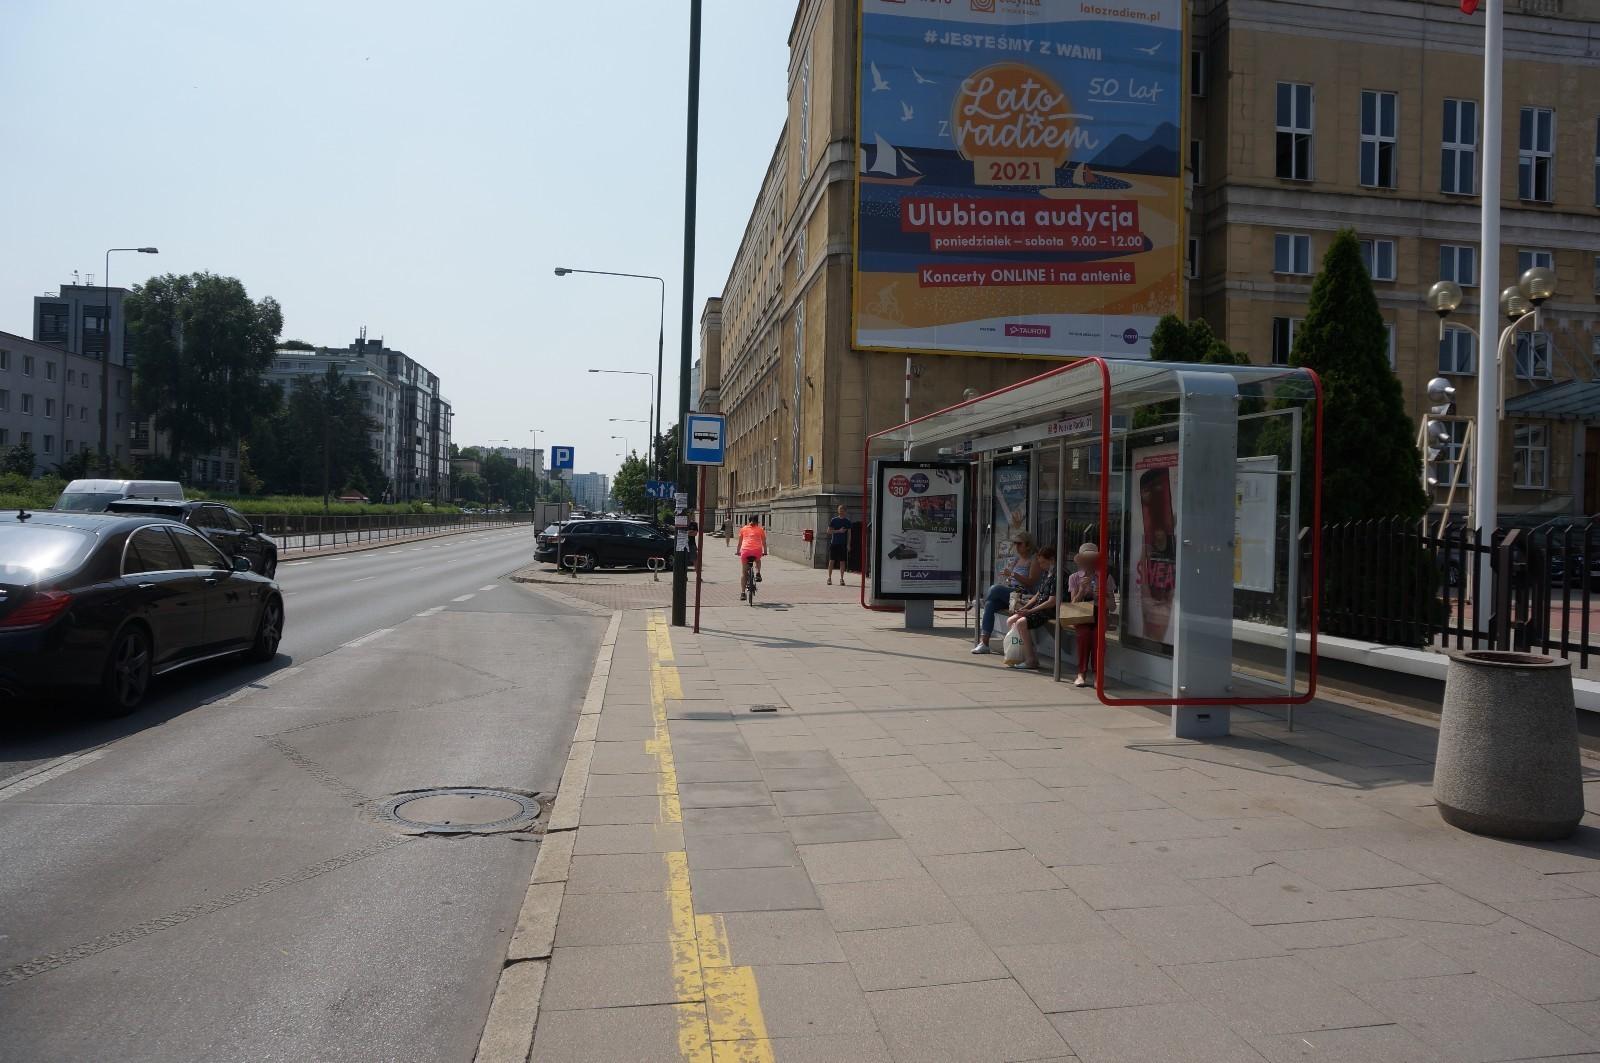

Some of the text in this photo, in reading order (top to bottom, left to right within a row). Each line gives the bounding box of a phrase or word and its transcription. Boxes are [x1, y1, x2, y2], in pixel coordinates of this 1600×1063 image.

[1080, 2, 1161, 23] latozradiem.pl
[924, 30, 1102, 61] #JESTEŚMY Z WAMI
[961, 77, 1064, 121] Lato
[1088, 77, 1164, 103] 50 lat
[989, 161, 1042, 182] 2021
[907, 202, 1134, 233] Ulubiona audycja
[934, 234, 1012, 250] poniedziałek
[1024, 235, 1064, 247] sobota
[1070, 235, 1097, 247] 9.00
[1110, 235, 1143, 247] 12.00
[922, 269, 1131, 285] Koncerty ONLINE i na antenie
[556, 448, 570, 466] P
[903, 571, 929, 579] PLAY
